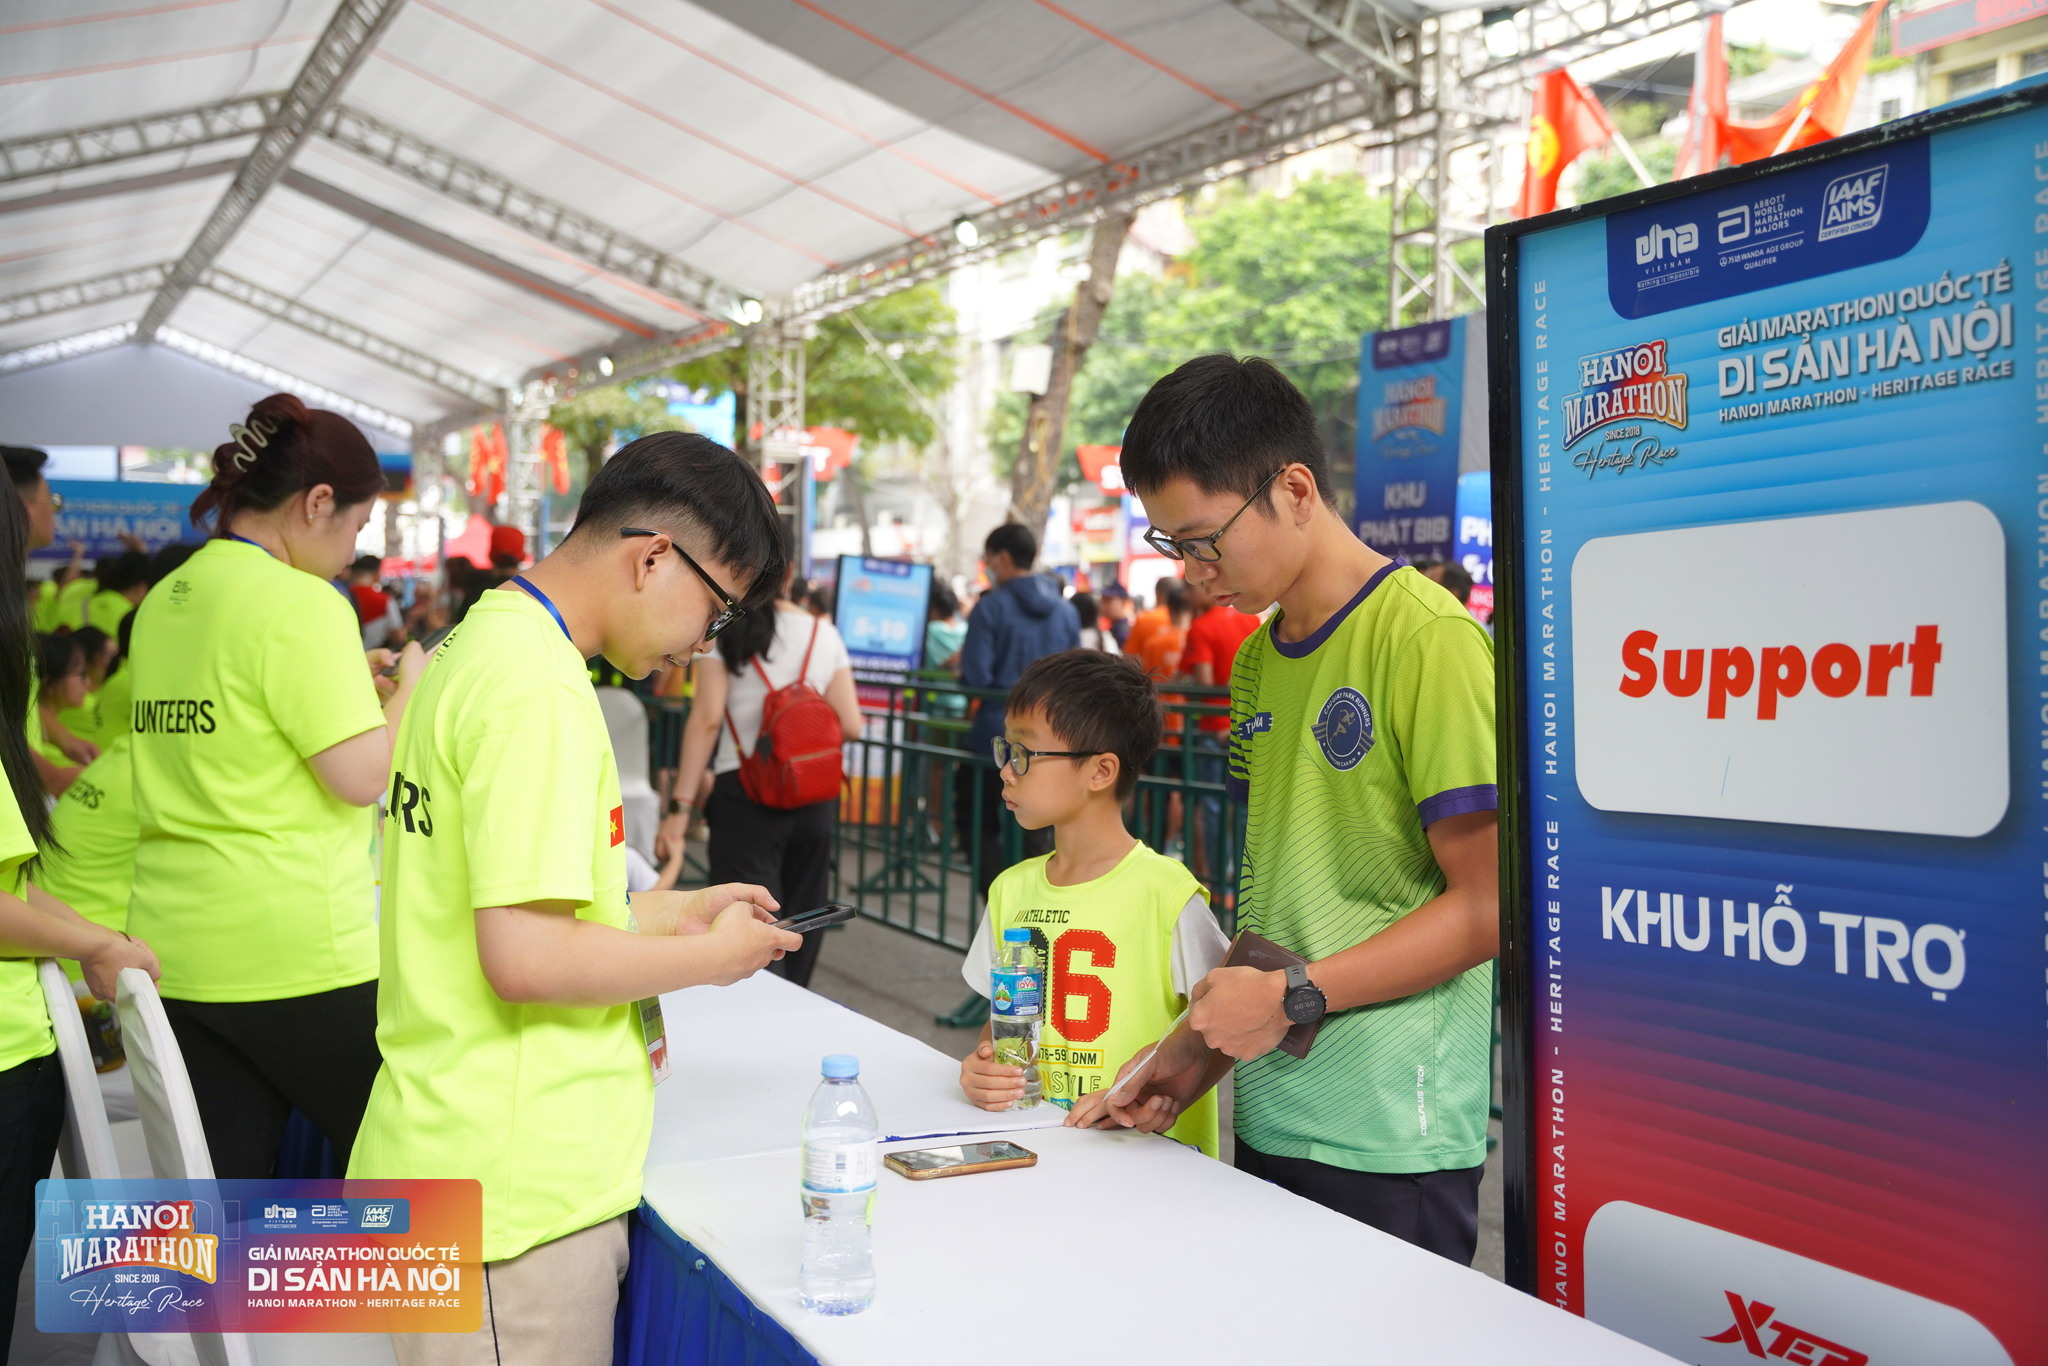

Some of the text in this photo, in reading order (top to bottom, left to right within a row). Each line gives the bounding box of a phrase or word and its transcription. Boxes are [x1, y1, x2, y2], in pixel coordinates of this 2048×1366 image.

[1754, 194, 1785, 210] ABBOTT
[1828, 172, 1882, 205] IAAF
[1754, 204, 1783, 217] WORLD
[1755, 207, 1803, 227] MARATHON
[1826, 194, 1875, 225] AIMS
[1755, 220, 1789, 235] MAJORS
[1821, 219, 1874, 238] CERTIFIED COURSE
[1645, 257, 1690, 274] VIETNAM
[1741, 238, 1803, 260] WANDA AGE GROUP
[1744, 256, 1777, 270] QUALIFIER
[1667, 268, 1699, 281] impossible
[1534, 279, 1548, 350] RACE
[1717, 257, 2011, 349] GIẢI MARATHON QUỐC TẾ
[1718, 300, 2012, 397] DI SẢN HÀ NỘI
[1582, 345, 1662, 387] HANOI
[1719, 402, 1764, 421] HANOI
[1767, 387, 1857, 414] MARATHON
[1871, 369, 1958, 397] HERITAGE
[1962, 360, 2012, 382] RACE
[1535, 360, 1551, 492] HERITAGE
[1565, 379, 1683, 444] MARATHON
[1605, 425, 1641, 441] SINCE 2018
[1573, 436, 1678, 479] Heritage Race
[1384, 482, 1426, 509] KHU
[1540, 528, 1555, 681] MARATHON
[1618, 624, 1942, 720] Support
[130, 700, 216, 734] UNTEERS
[1355, 697, 1371, 727] RUNNERS
[1544, 693, 1557, 775] HANOI
[1546, 821, 1560, 890] RACE
[1023, 910, 1070, 923] ATHLETIC
[1602, 884, 1966, 1002] KHU HỖ TRỢ
[1548, 901, 1562, 1033] HERITAGE
[1416, 1065, 1424, 1088] TECH
[1552, 1069, 1566, 1222] MARATHON
[1554, 1231, 1567, 1310] HANOI
